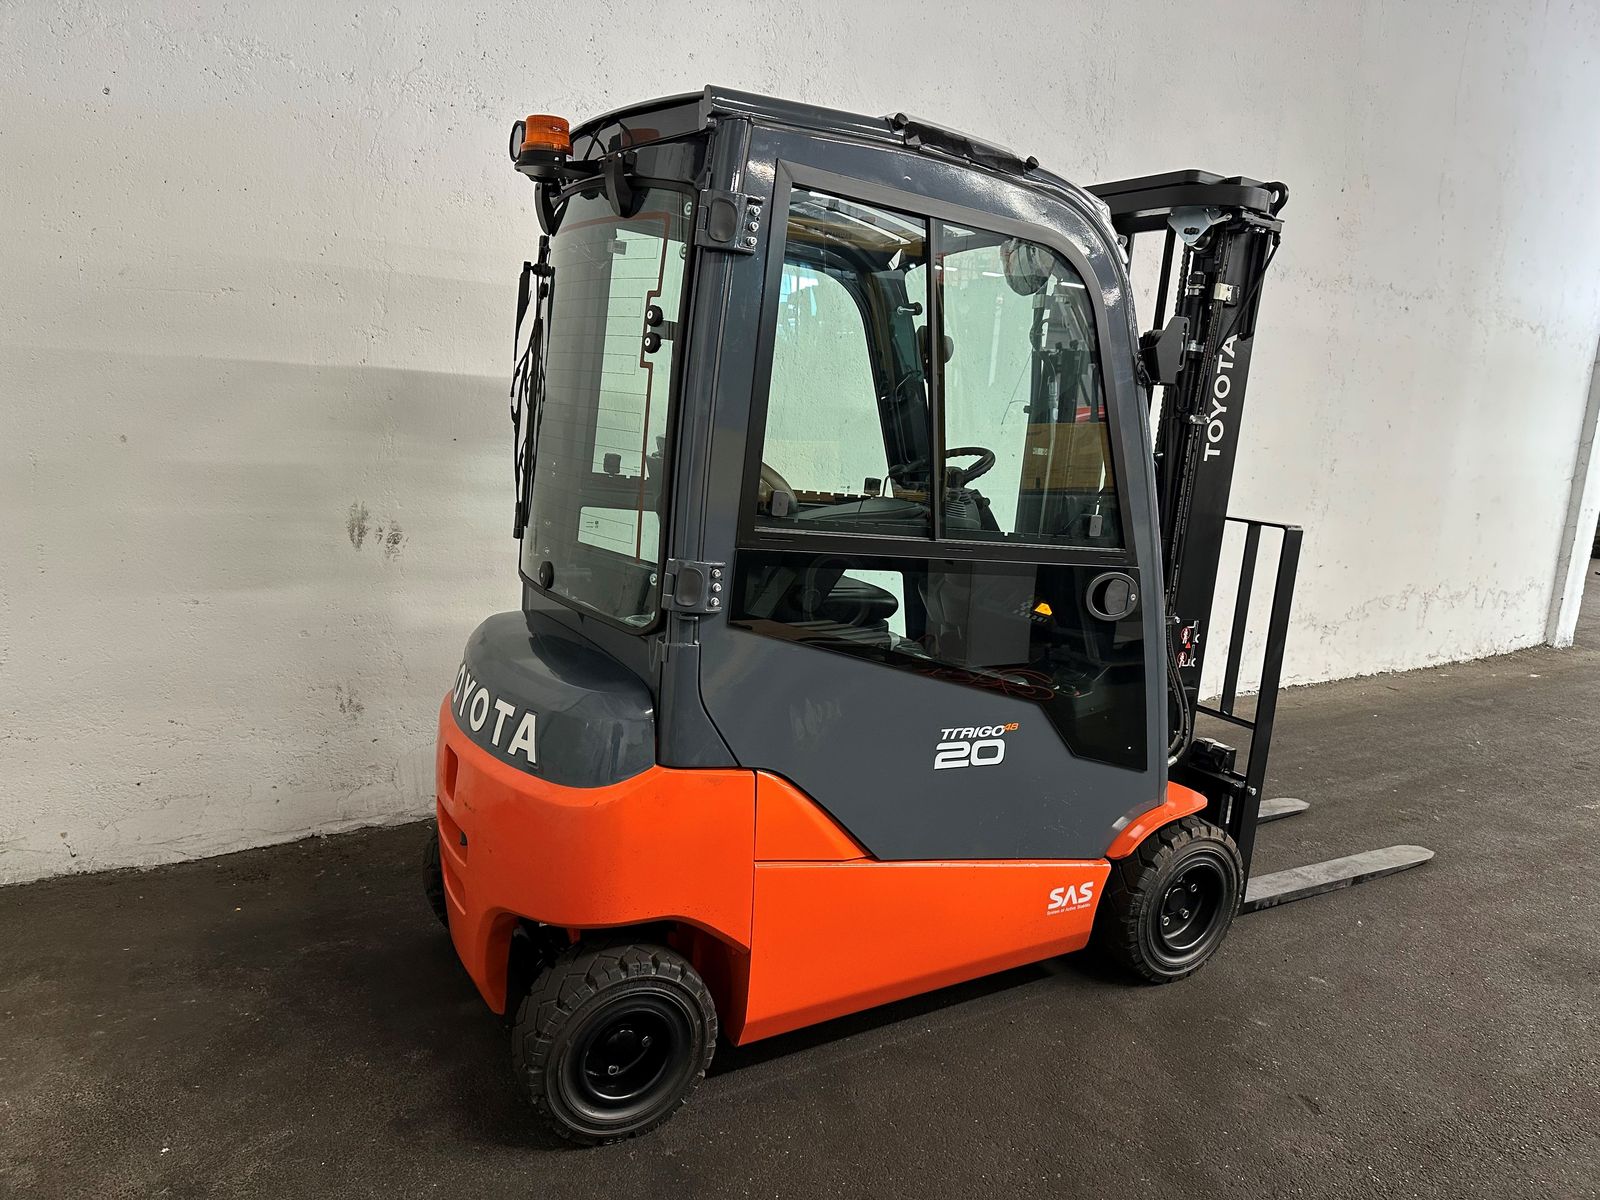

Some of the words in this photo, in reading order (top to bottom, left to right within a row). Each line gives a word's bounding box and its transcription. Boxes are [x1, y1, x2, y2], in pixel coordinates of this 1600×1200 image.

[1203, 334, 1238, 461] TOYOTA
[453, 664, 537, 763] OYOTA
[934, 738, 1006, 770] 20
[1047, 881, 1094, 909] SAS
